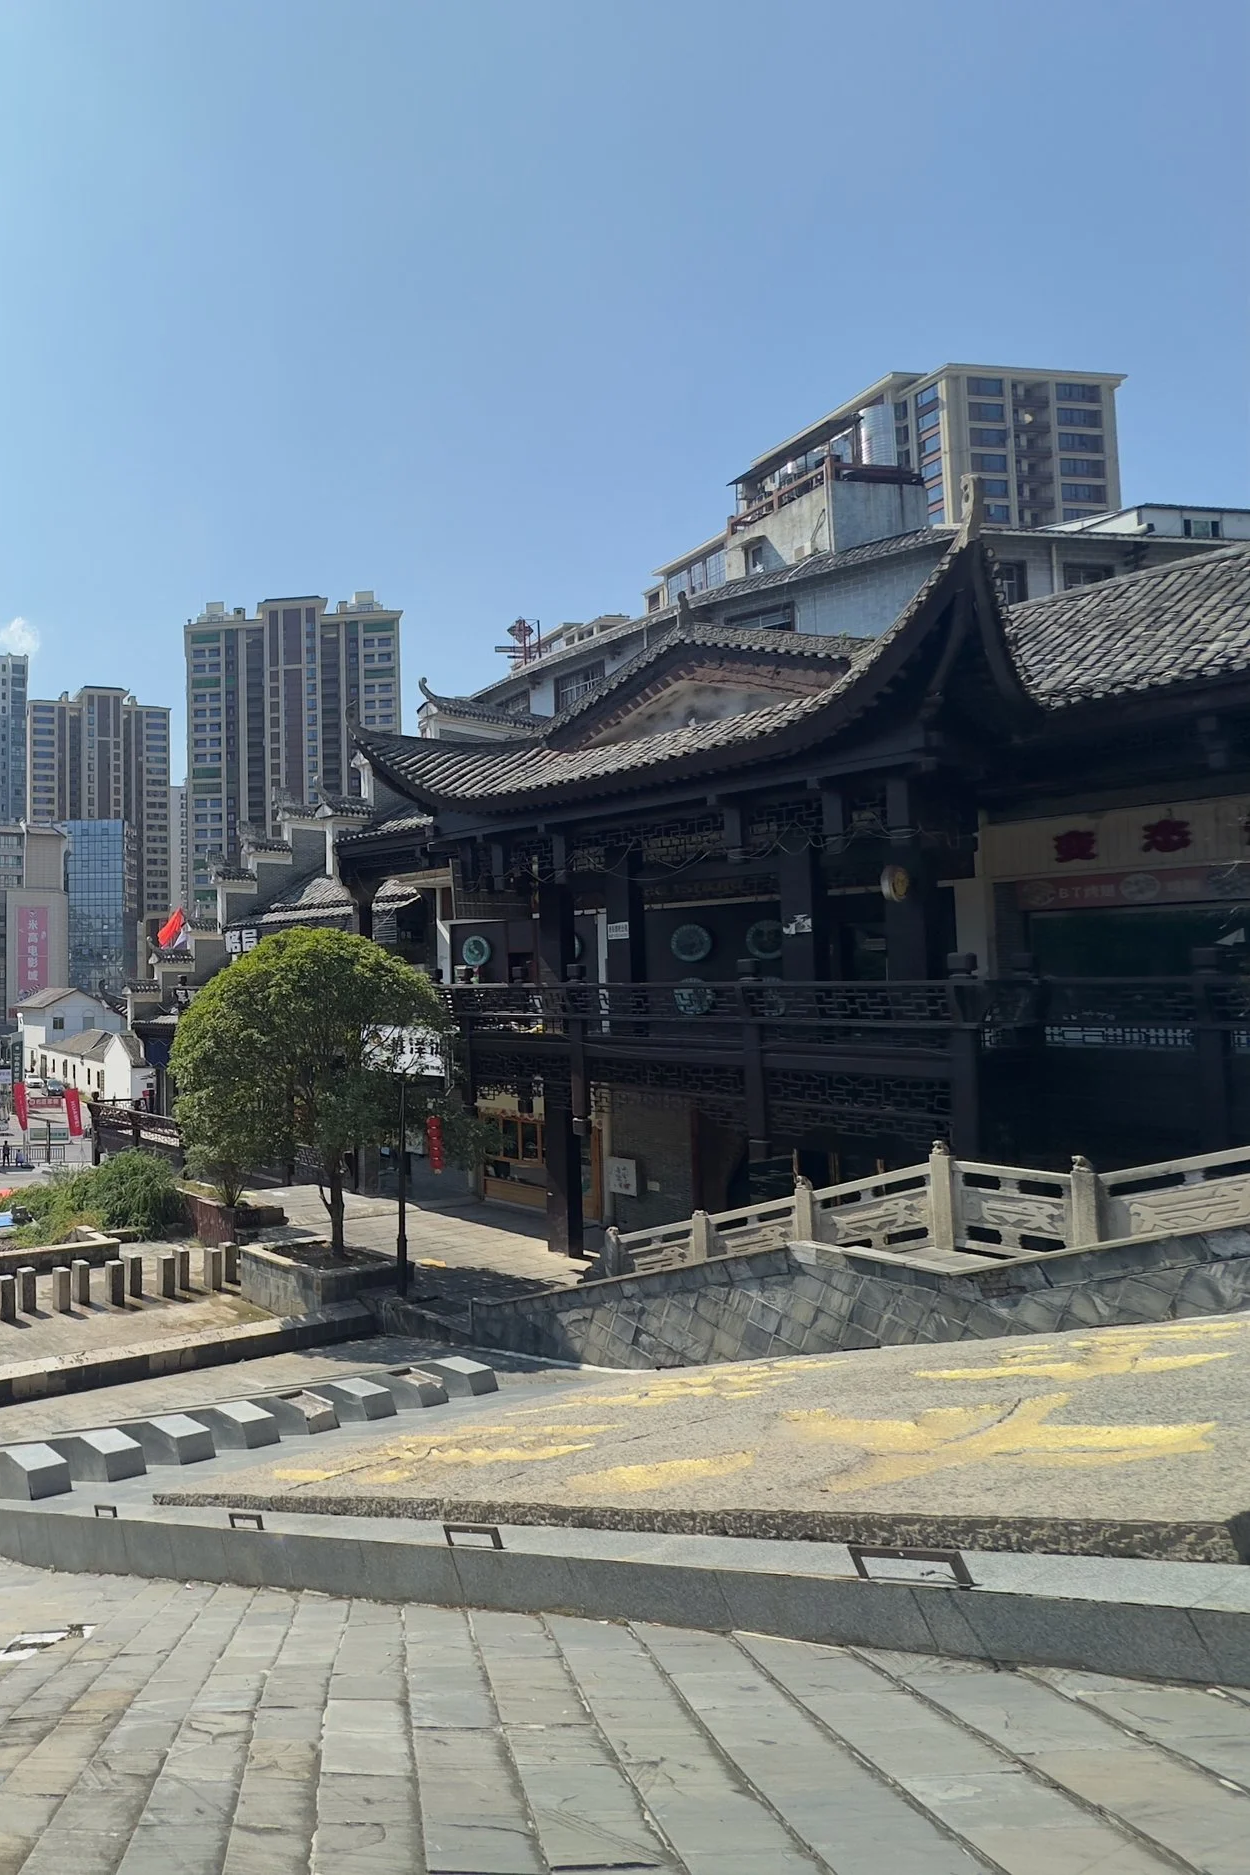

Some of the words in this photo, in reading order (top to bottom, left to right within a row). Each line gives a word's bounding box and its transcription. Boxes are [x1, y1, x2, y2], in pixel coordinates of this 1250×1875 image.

[27, 918, 39, 981] 米高电影城
